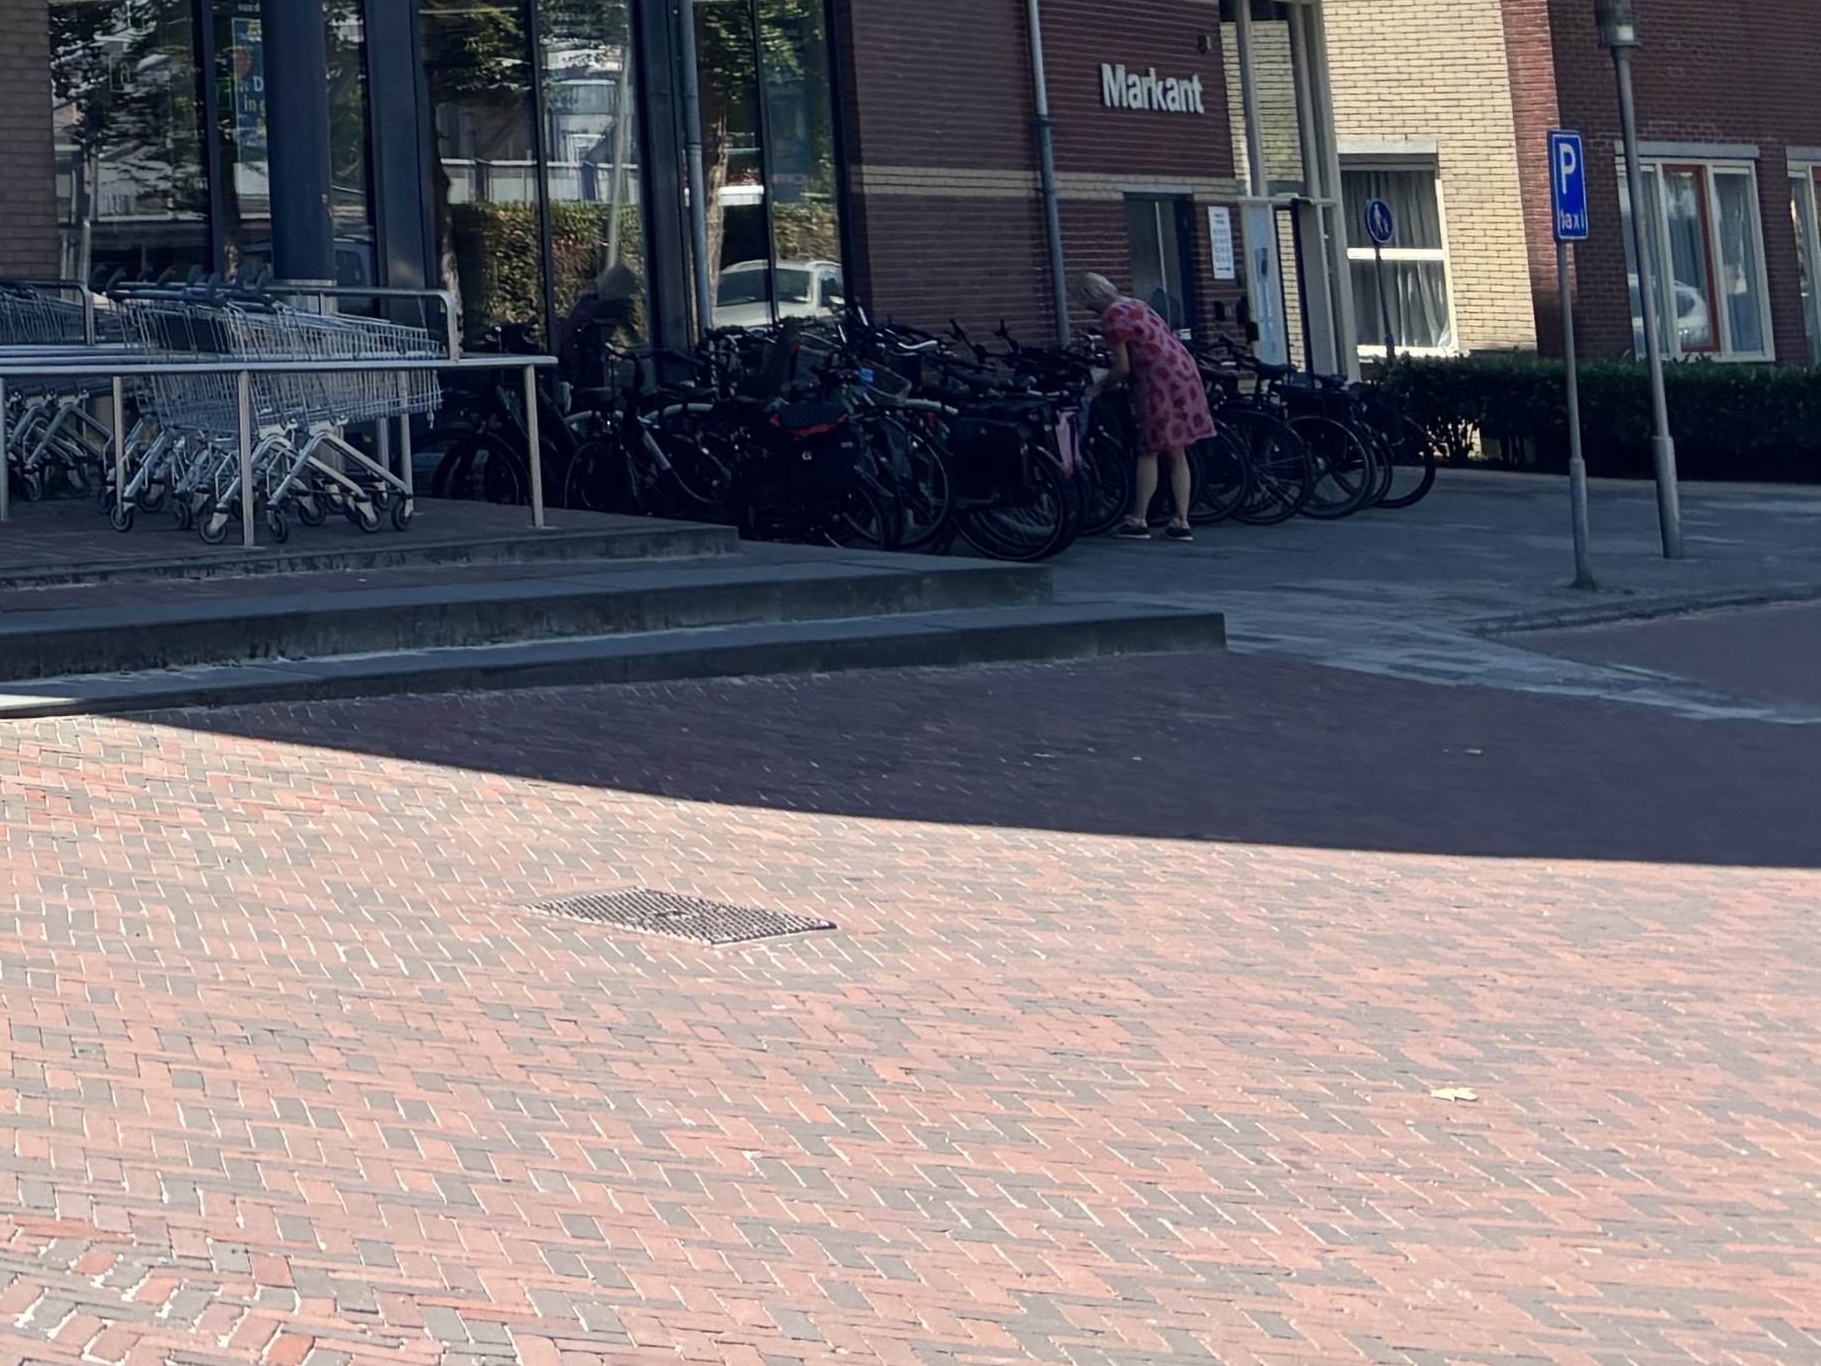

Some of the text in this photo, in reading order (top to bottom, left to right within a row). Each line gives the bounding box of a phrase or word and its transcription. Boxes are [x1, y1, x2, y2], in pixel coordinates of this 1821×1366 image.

[1100, 62, 1205, 114] Markant
[1558, 142, 1577, 195] P
[1561, 207, 1585, 230] taxi
